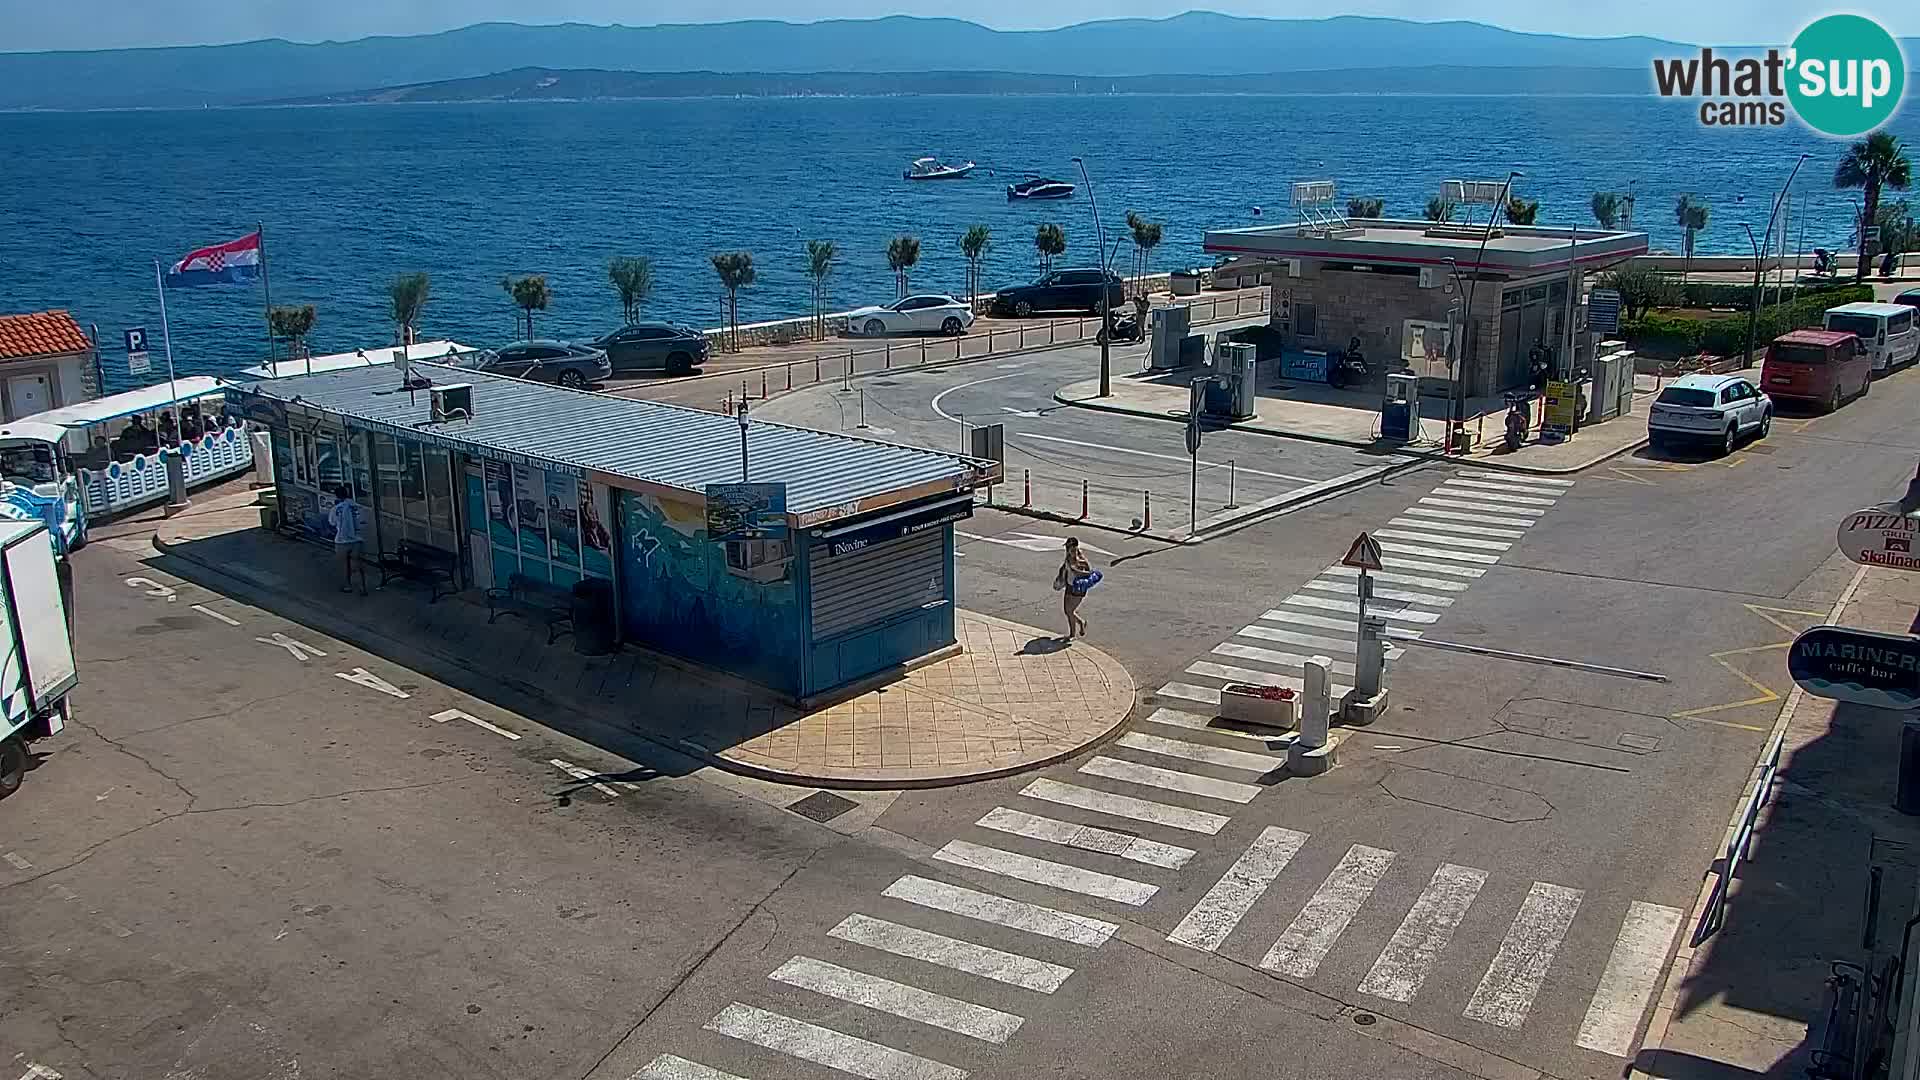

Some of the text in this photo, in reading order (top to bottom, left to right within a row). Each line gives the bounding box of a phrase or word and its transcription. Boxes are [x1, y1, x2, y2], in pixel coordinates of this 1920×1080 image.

[129, 331, 142, 350] P
[478, 447, 492, 458] BUS
[494, 450, 526, 465] STATION
[528, 457, 554, 472] TICKET
[555, 463, 582, 477] OFFICE
[1848, 515, 1920, 533] PIZZE
[1871, 666, 1897, 680] bar
